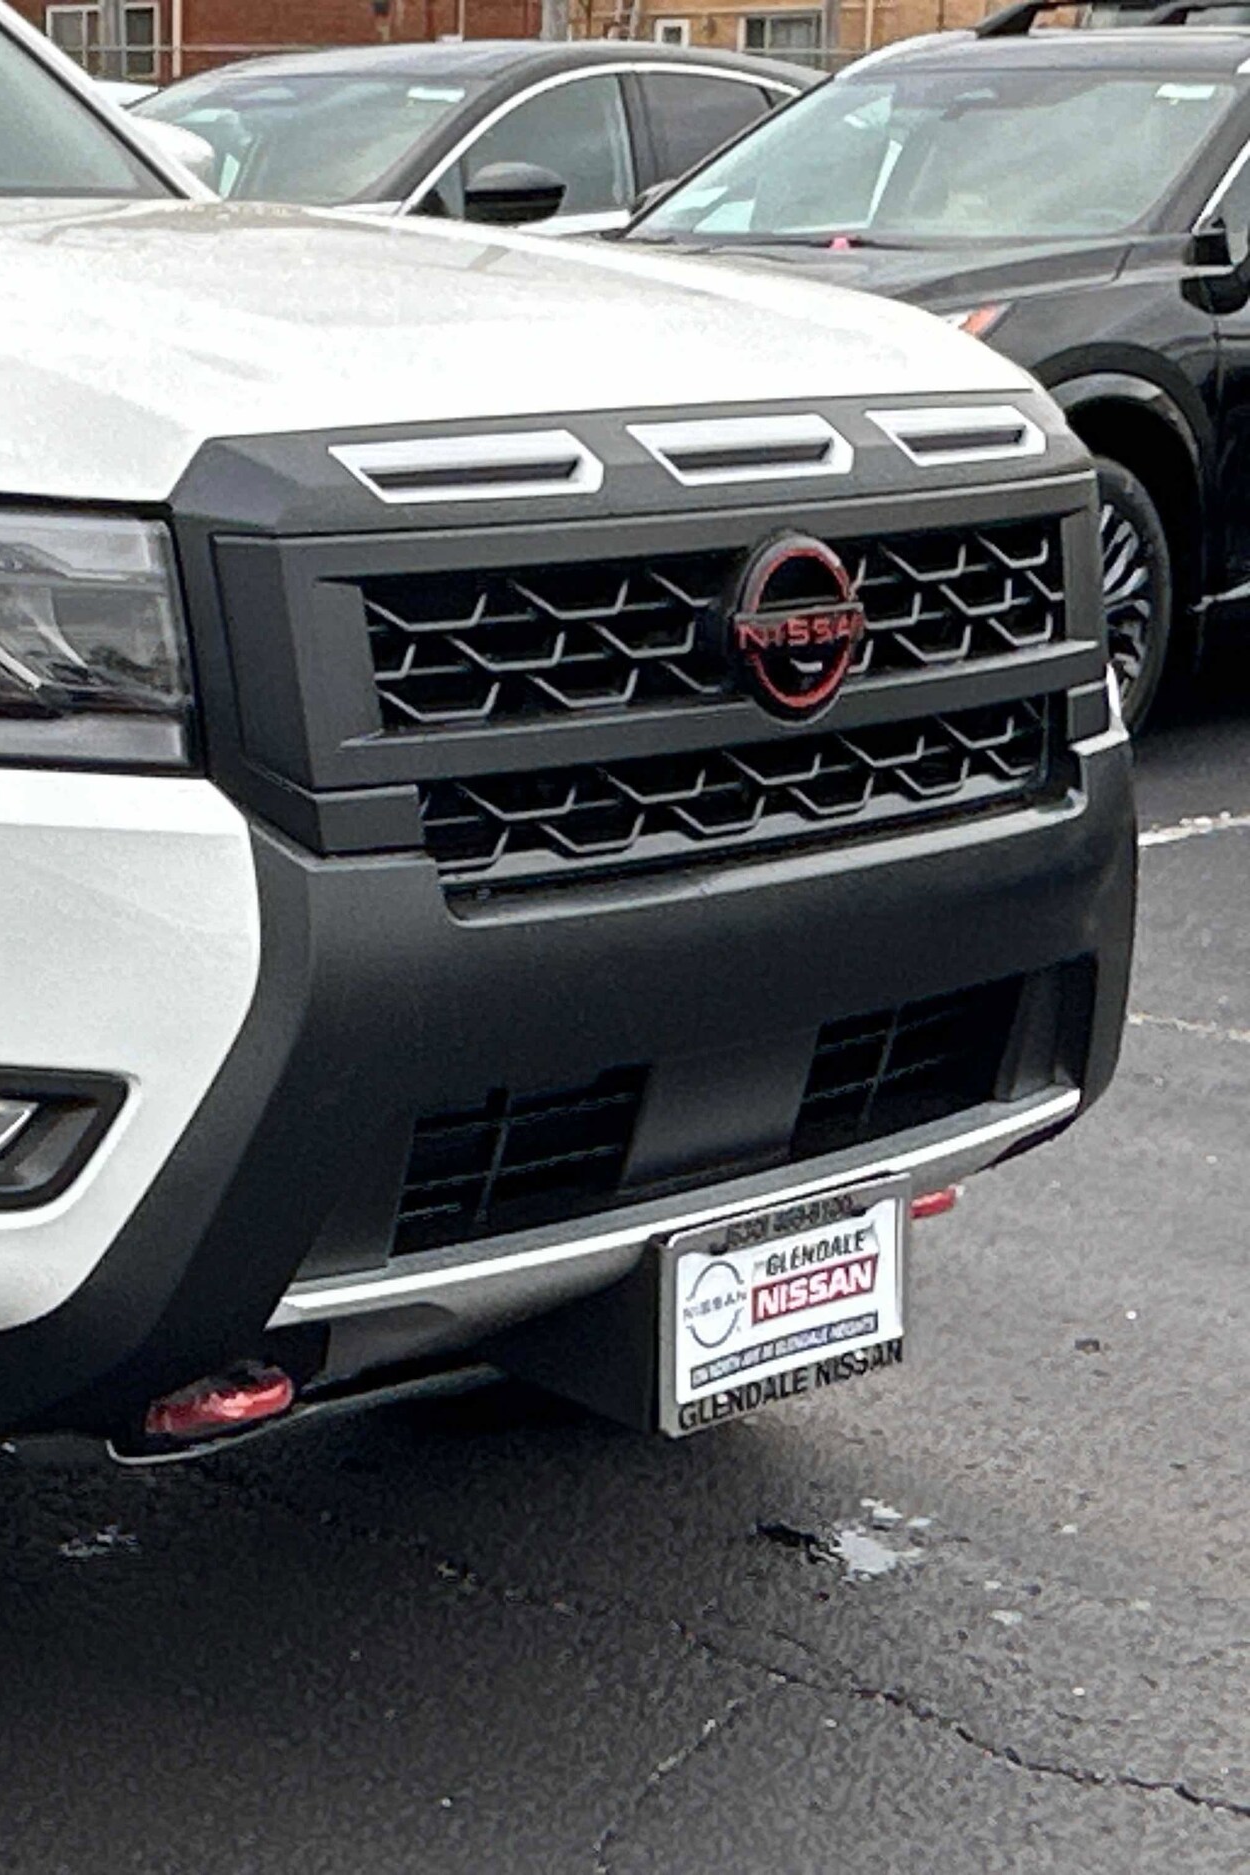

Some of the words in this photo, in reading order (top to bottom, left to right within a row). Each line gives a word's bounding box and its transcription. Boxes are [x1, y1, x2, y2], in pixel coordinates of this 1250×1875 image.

[766, 1228, 864, 1276] GLENDALE
[683, 1291, 747, 1321] NISSAN
[757, 1260, 873, 1318] NISSAN
[678, 1366, 808, 1430] GLENDALE
[816, 1337, 903, 1387] NISSAN
